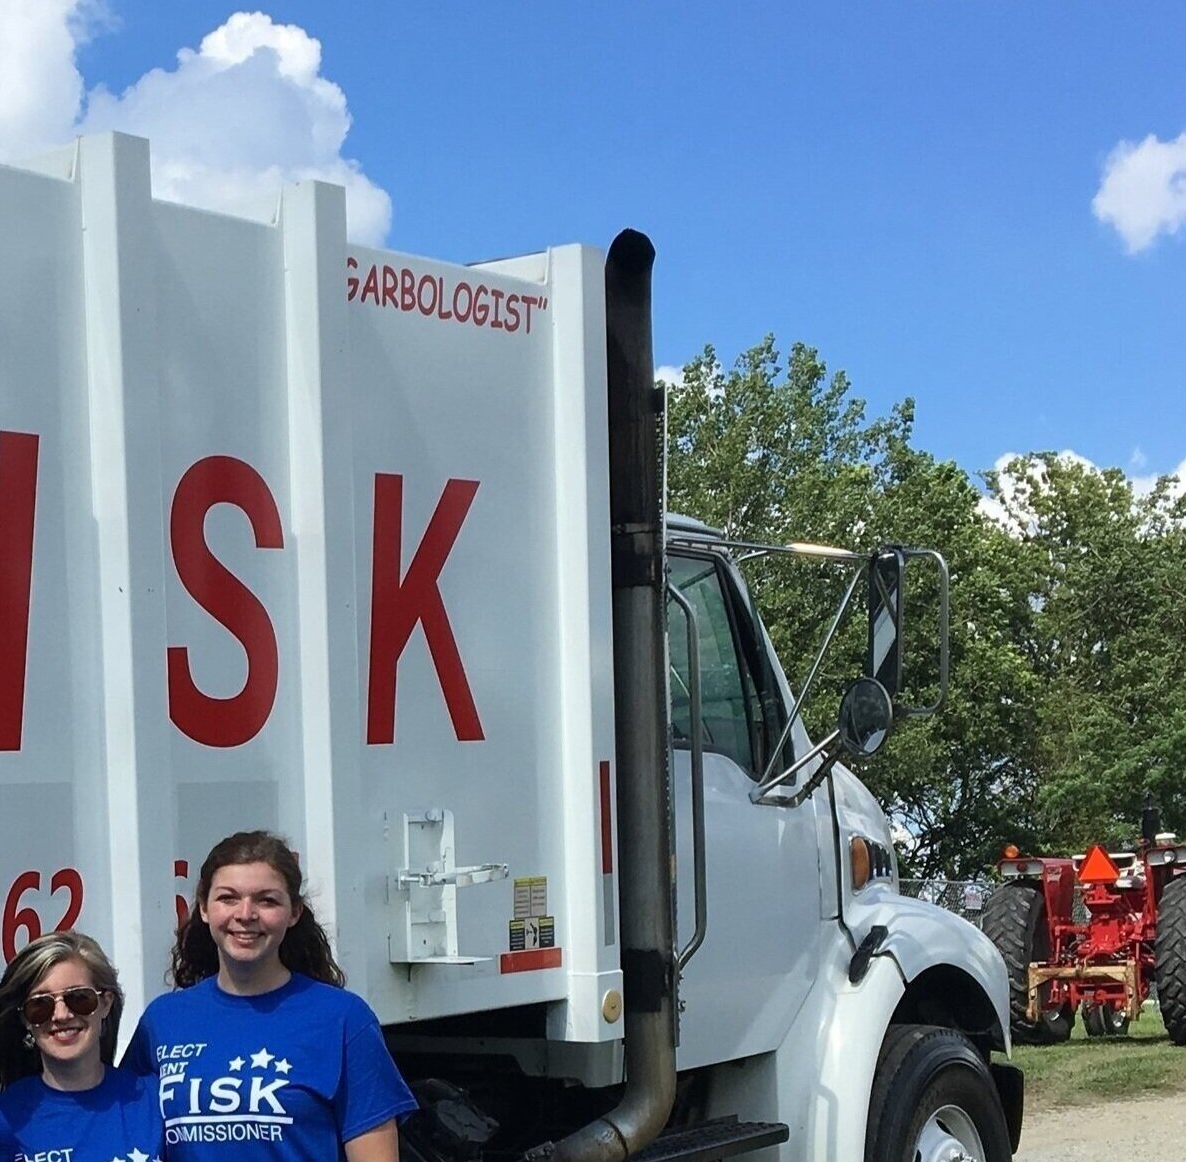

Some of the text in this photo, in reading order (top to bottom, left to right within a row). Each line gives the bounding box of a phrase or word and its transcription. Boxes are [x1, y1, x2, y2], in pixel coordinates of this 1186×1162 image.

[157, 1043, 207, 1062] ELECT
[160, 1062, 188, 1079] ENT
[159, 1073, 290, 1119] FISK
[166, 1123, 283, 1146] OMMISSIONER
